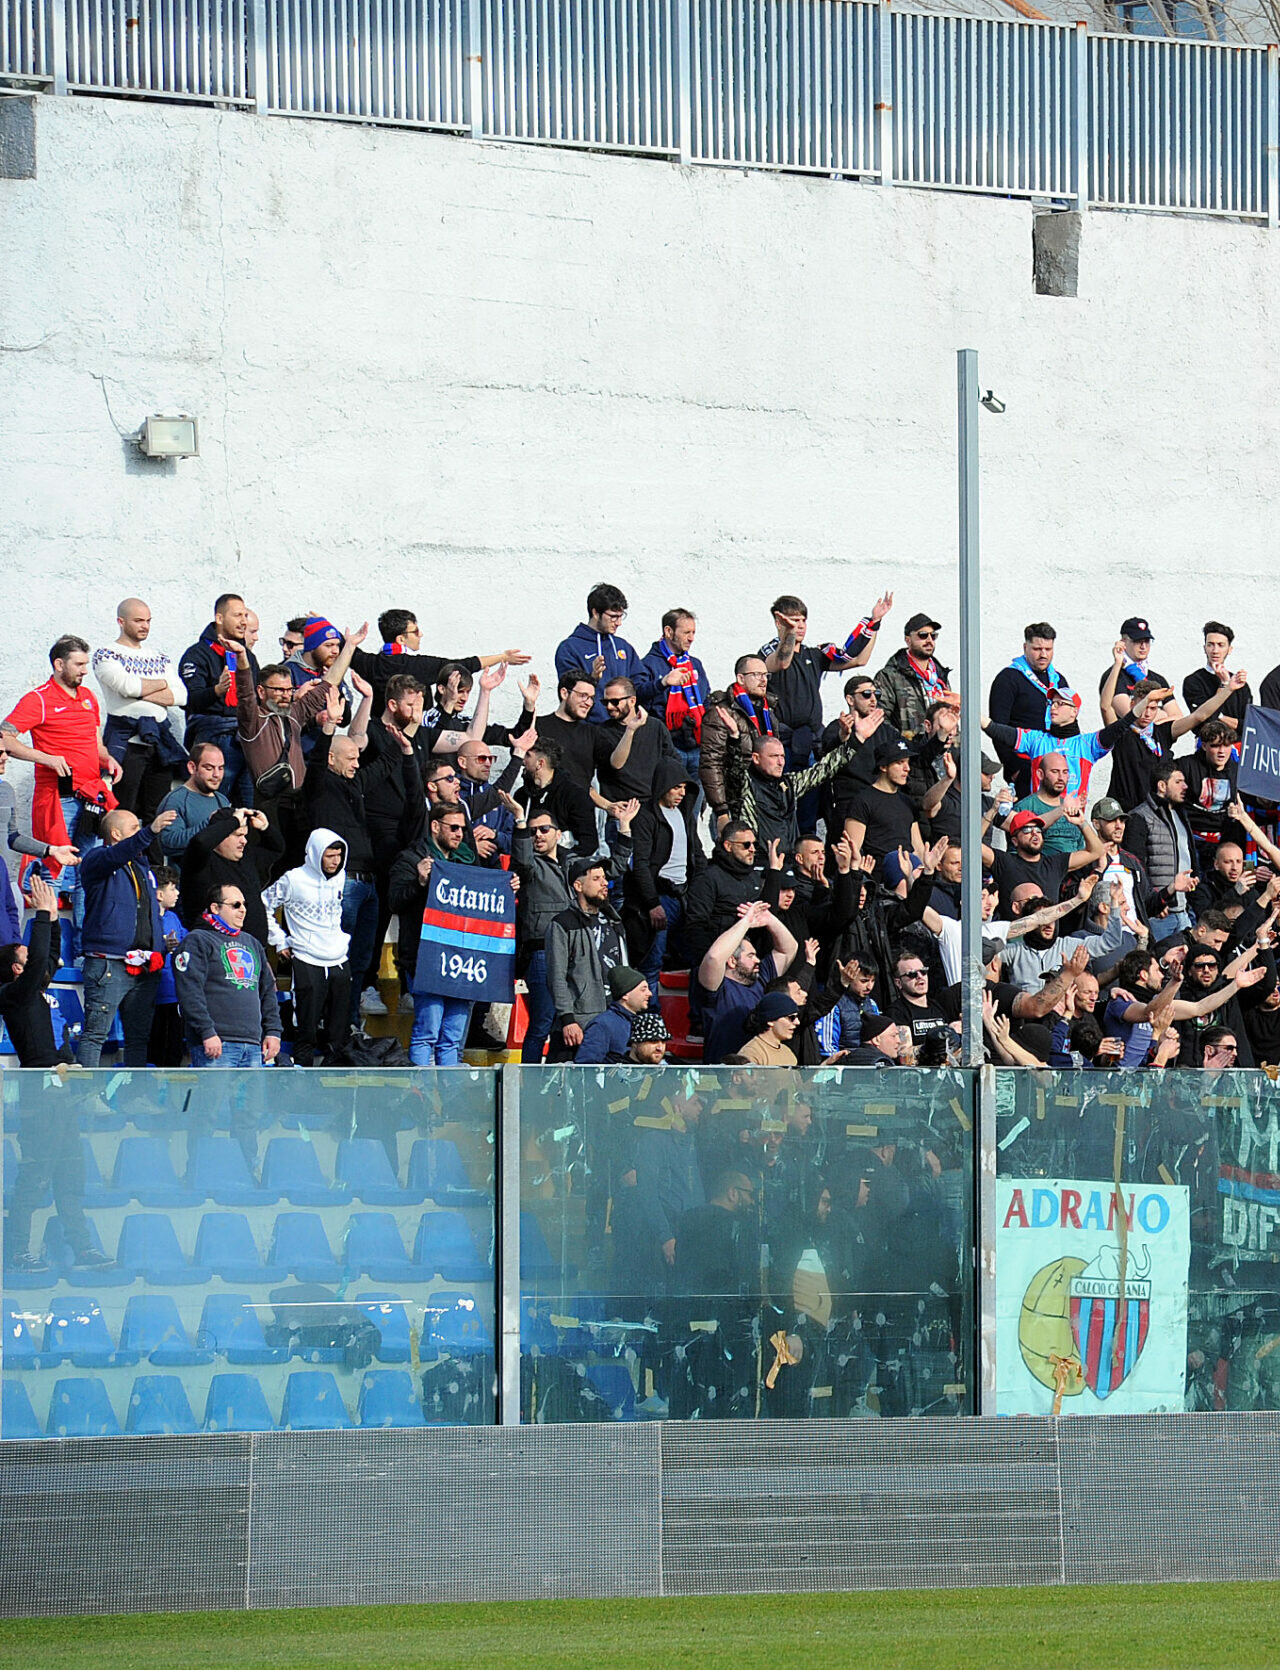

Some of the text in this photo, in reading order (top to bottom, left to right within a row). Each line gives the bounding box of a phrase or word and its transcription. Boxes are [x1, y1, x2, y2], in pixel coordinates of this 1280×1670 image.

[435, 878, 505, 914] Catania
[440, 951, 487, 983] 1946
[1002, 1188, 1170, 1234] ADRANO
[1075, 1281, 1146, 1297] CALCIO CAANIA
